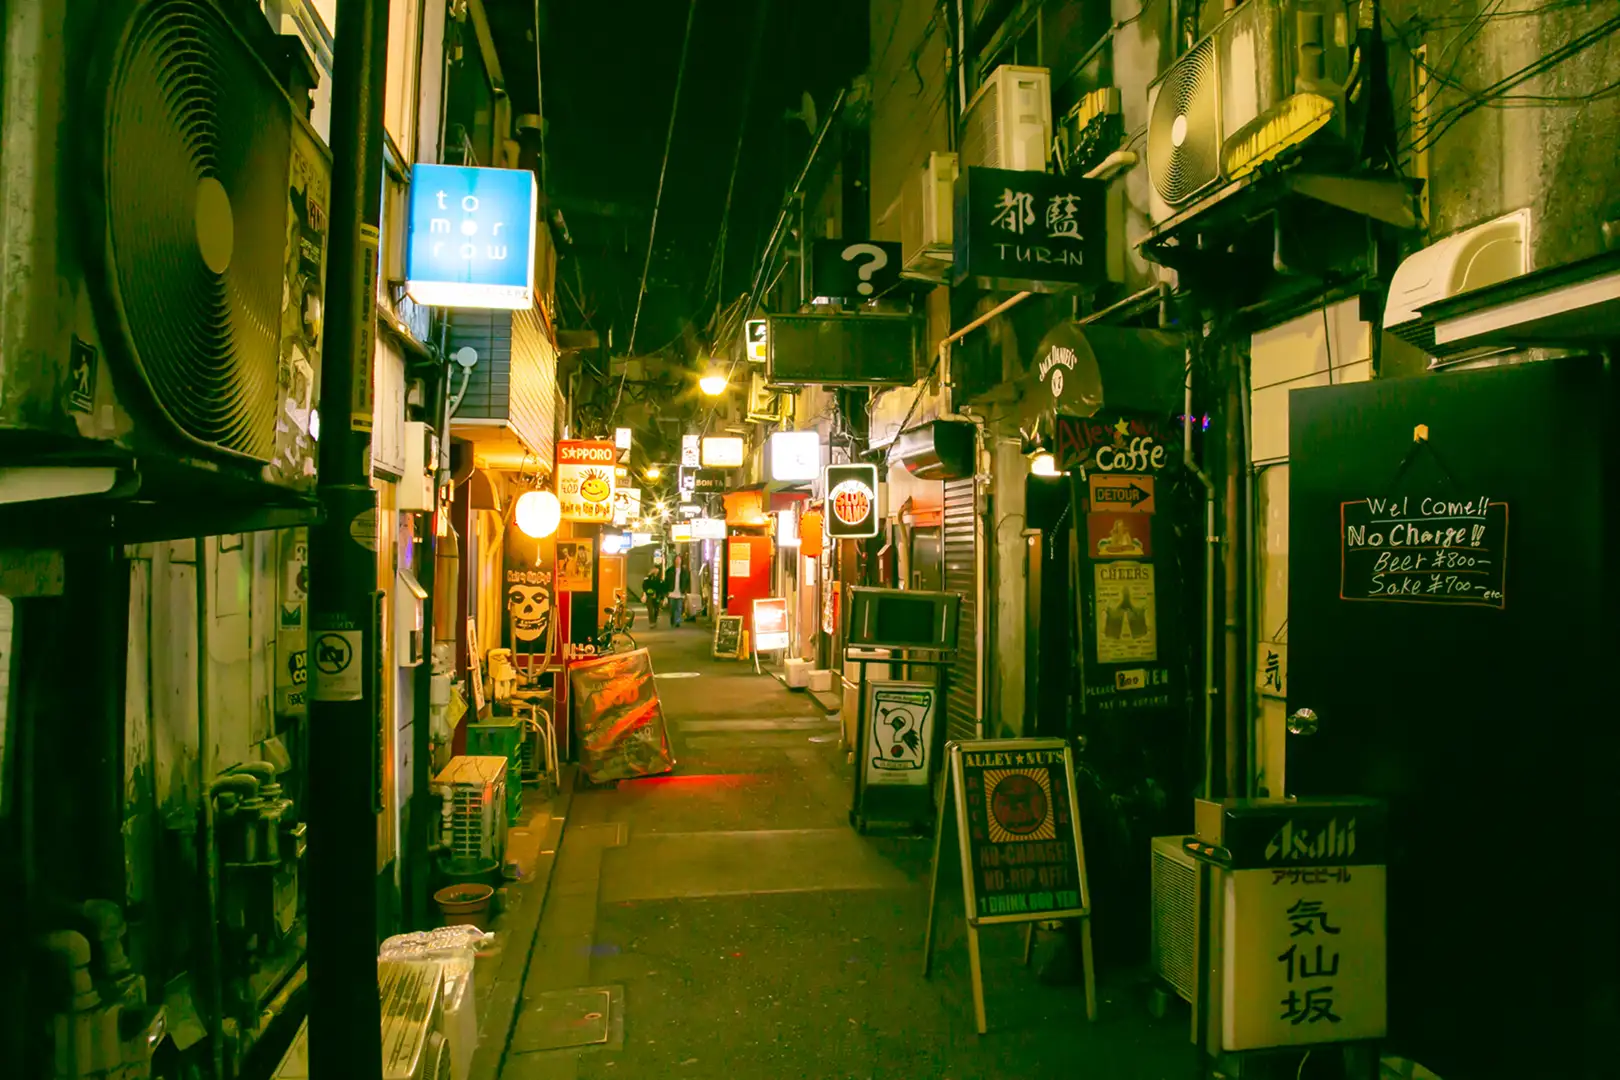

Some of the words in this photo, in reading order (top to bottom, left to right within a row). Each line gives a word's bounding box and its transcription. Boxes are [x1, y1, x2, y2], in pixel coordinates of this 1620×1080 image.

[1096, 436, 1166, 472] Caffe
[1097, 488, 1140, 501] DETOUR
[1366, 496, 1408, 517] Wel
[1348, 525, 1383, 547] No
[1373, 551, 1428, 572] Beer
[1100, 568, 1150, 580] CHEERS
[1368, 573, 1422, 595] Sake
[965, 753, 1013, 768] ALLEY
[1026, 750, 1065, 765] NUTS
[1264, 816, 1356, 861] Asahi
[1272, 867, 1352, 885] アサヒビール
[1277, 898, 1342, 1026] 気仙坂
